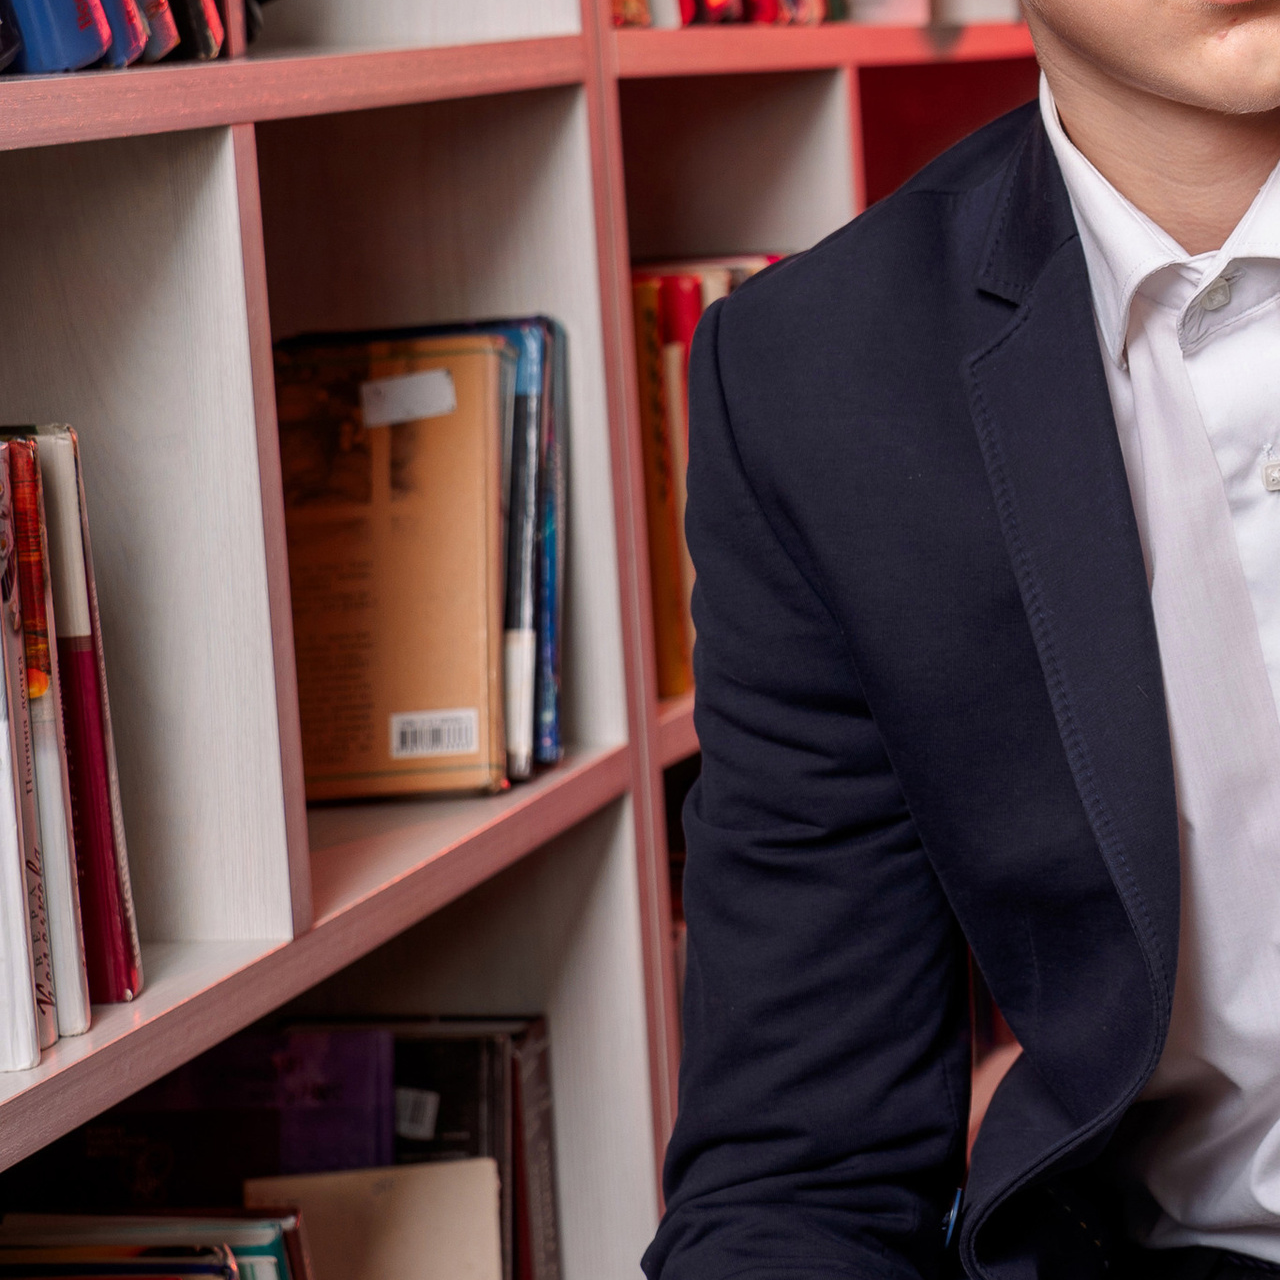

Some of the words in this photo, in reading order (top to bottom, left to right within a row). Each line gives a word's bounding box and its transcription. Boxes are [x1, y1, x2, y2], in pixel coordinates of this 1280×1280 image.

[16, 655, 27, 710] дочка
[22, 727, 33, 795] Папина
[30, 887, 43, 966] ВЕРА
